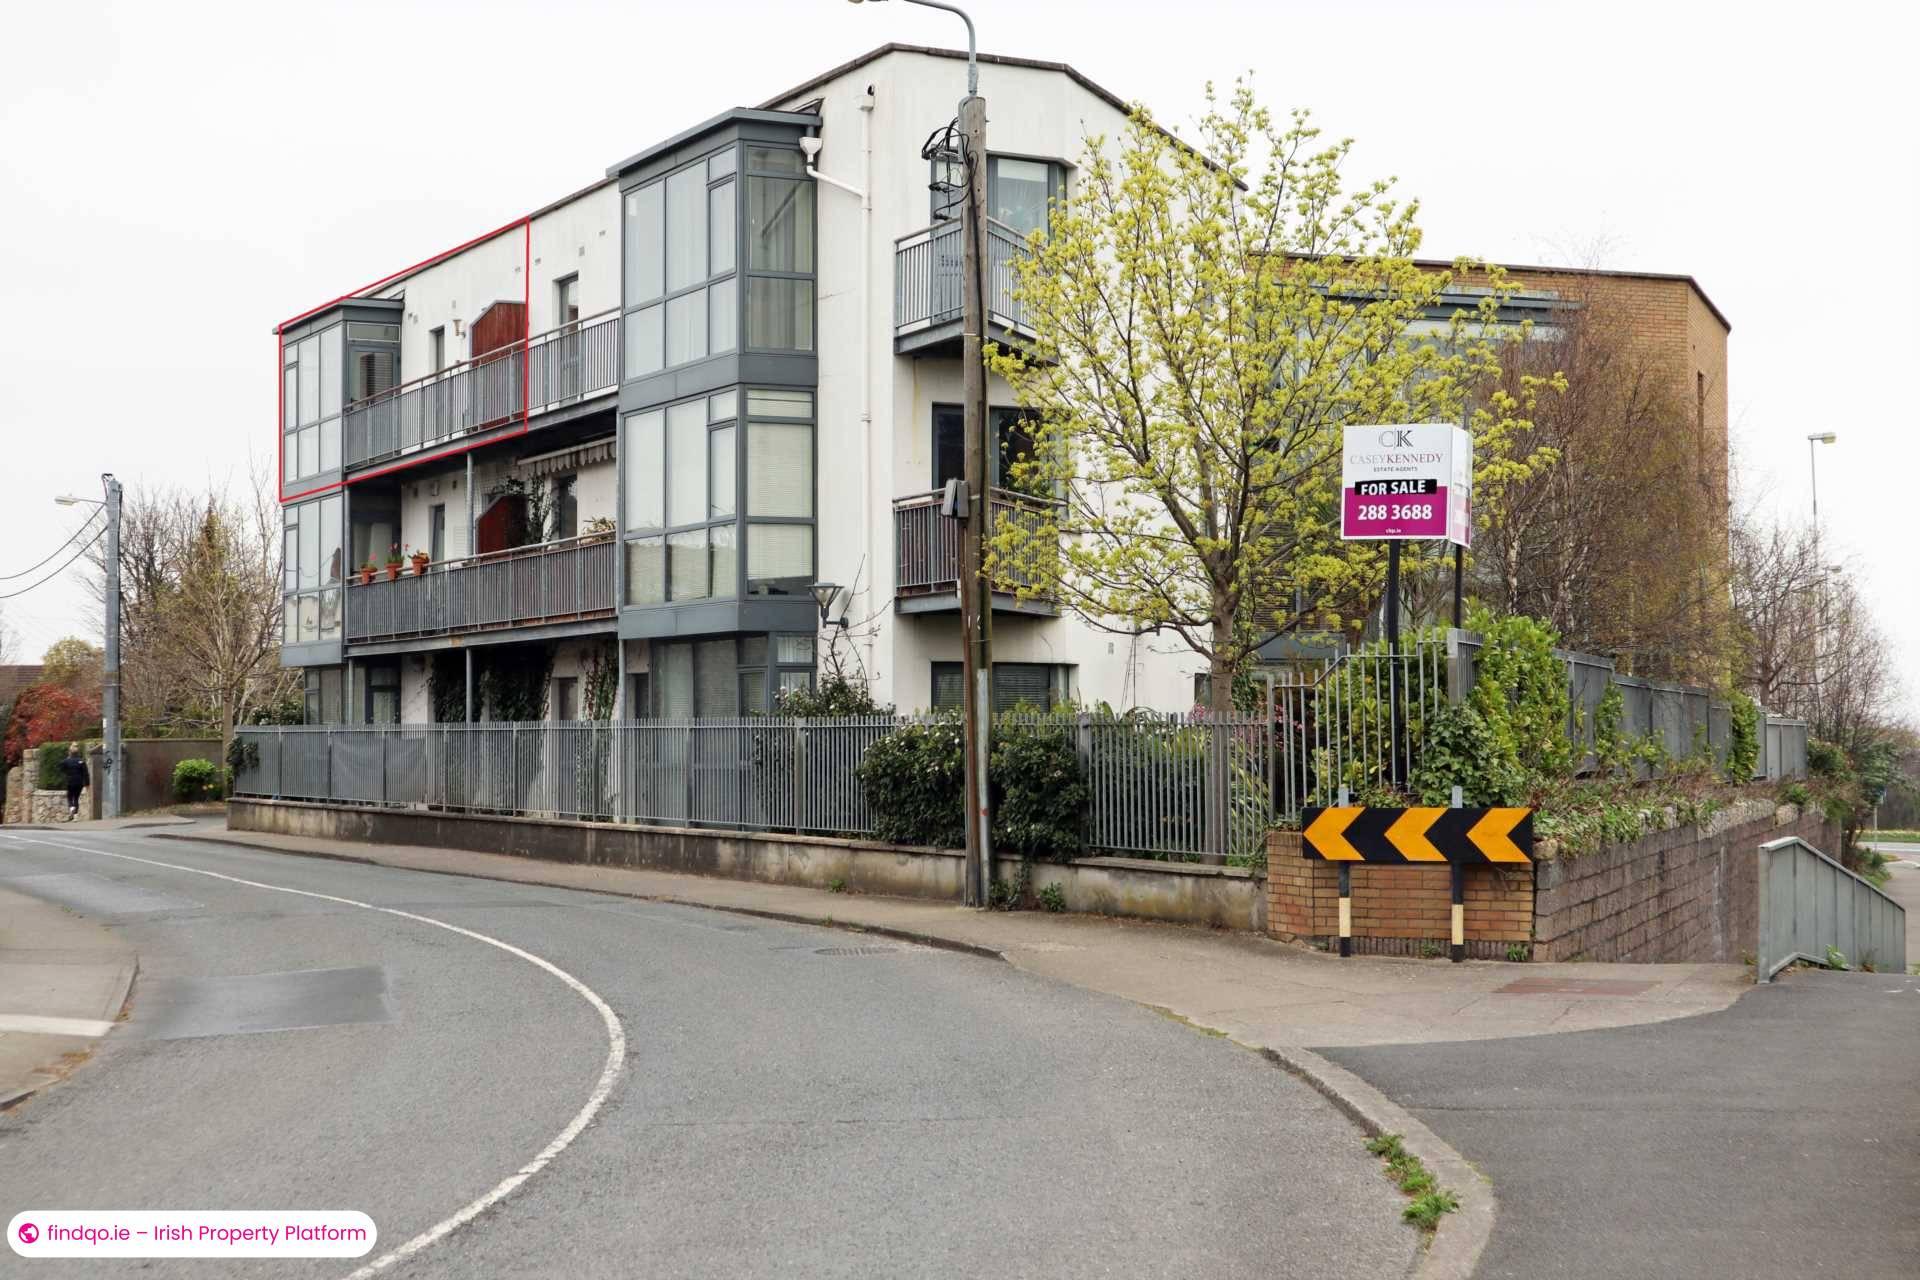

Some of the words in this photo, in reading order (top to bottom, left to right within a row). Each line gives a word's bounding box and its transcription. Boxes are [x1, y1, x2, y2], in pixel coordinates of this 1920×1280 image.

[1361, 483, 1387, 496] FOR
[1390, 480, 1426, 494] SALE
[1357, 505, 1387, 520] 288
[1391, 504, 1432, 520] 3688
